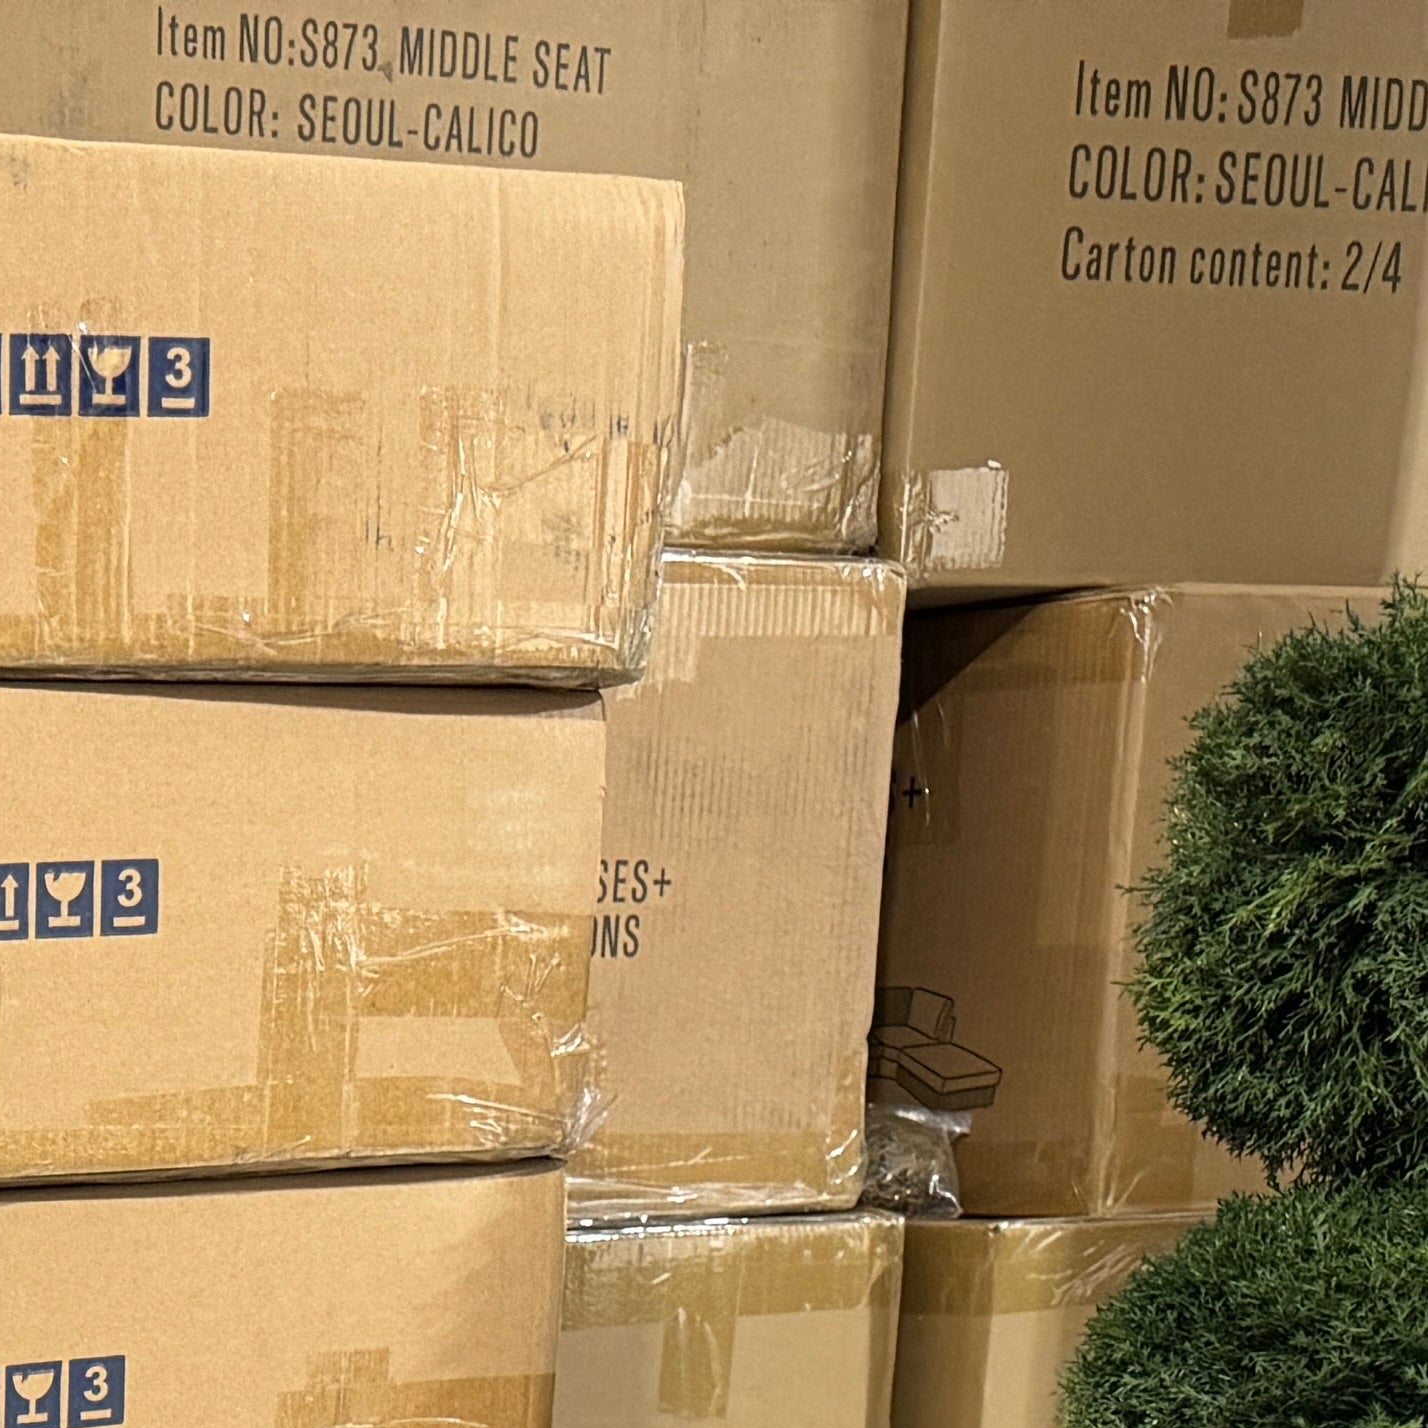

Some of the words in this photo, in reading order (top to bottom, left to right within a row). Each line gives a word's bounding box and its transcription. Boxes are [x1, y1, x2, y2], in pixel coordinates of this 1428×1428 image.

[156, 6, 225, 61] Item
[399, 25, 518, 85] MIDDLE
[533, 40, 611, 95] SEAT
[1075, 59, 1152, 119] Item
[156, 80, 280, 138] COLOR:
[297, 92, 540, 159] SEOUL-CALICO
[1061, 225, 1176, 285] Carton
[1189, 242, 1330, 290] content:
[1341, 240, 1403, 293] 2/4
[165, 347, 192, 388] 3
[117, 868, 143, 908] 3
[82, 1365, 109, 1402] 3
